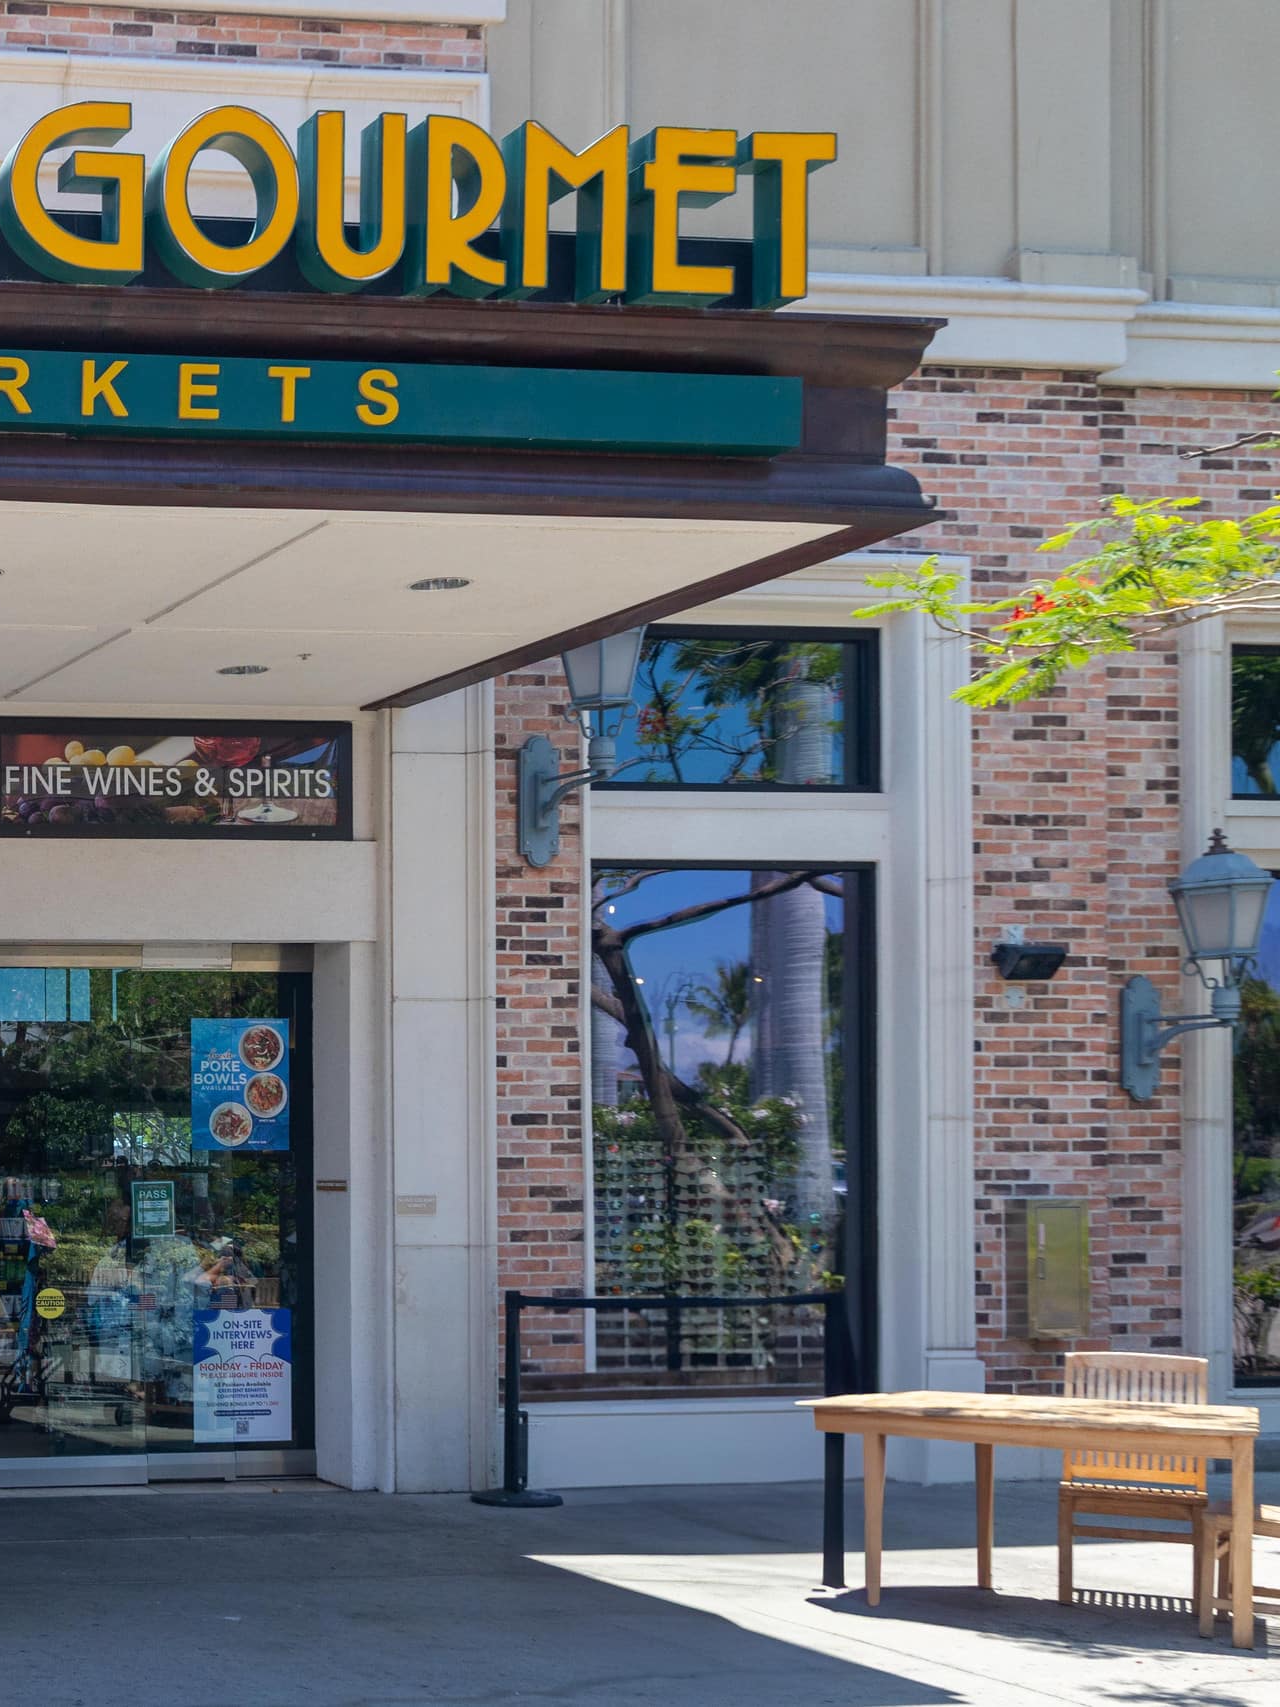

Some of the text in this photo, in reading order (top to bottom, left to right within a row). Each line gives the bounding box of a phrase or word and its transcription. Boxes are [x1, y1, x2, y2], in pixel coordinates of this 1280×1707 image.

[2, 100, 838, 304] GOURMET
[4, 765, 332, 799] FINE WINES & SPIRITS
[200, 1060, 240, 1072] POKE
[193, 1073, 248, 1085] BOWLS
[139, 1190, 168, 1199] PASS
[223, 1320, 262, 1329] ON-SITE
[213, 1330, 272, 1339] INTERVIEWS
[231, 1341, 255, 1349] HERE
[199, 1362, 241, 1372] MONDAY
[249, 1361, 285, 1370] FRIDAY
